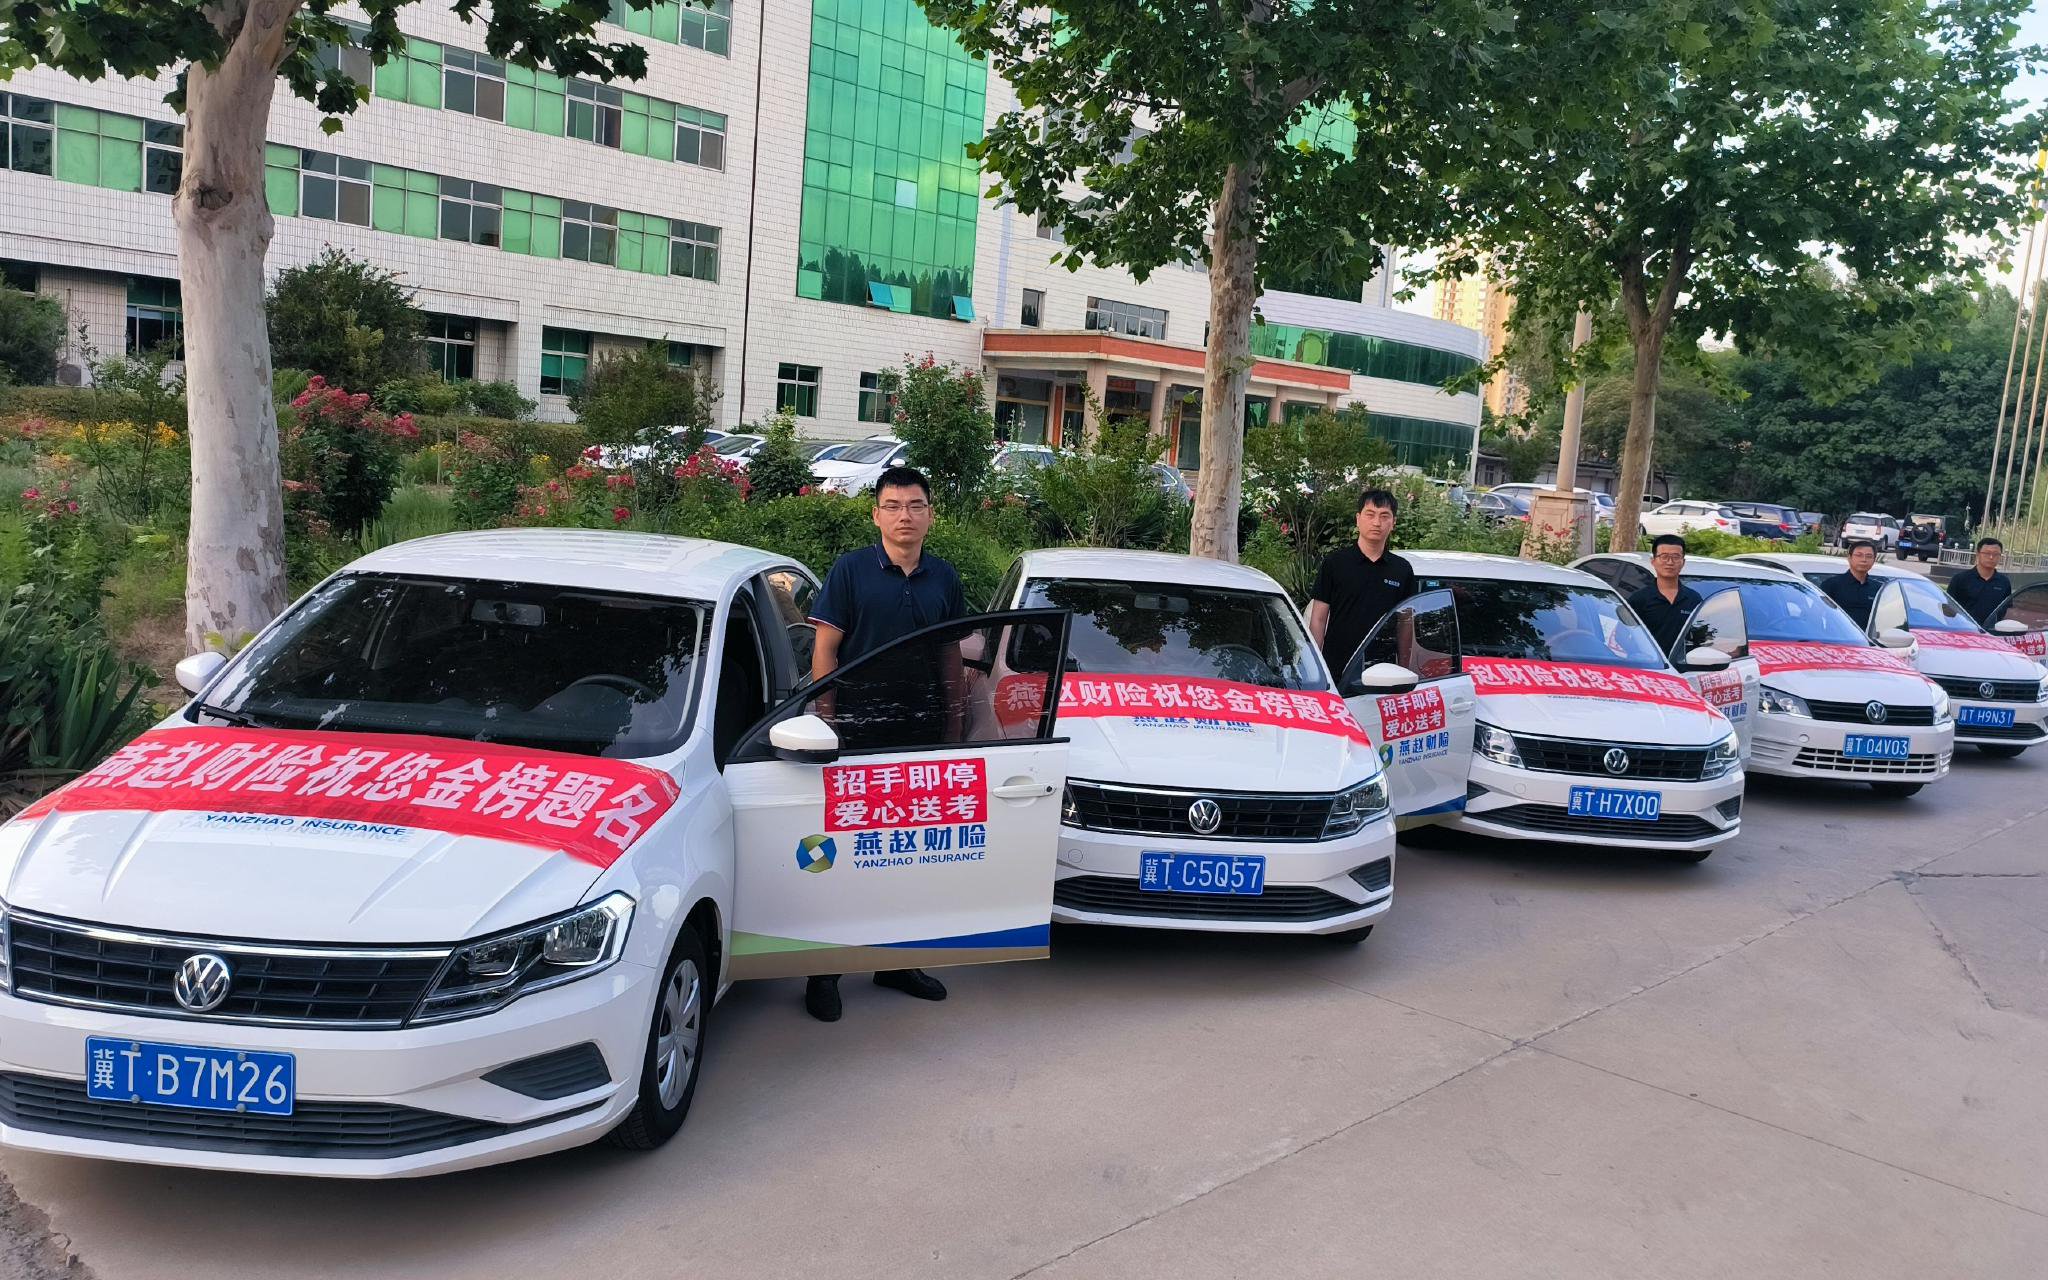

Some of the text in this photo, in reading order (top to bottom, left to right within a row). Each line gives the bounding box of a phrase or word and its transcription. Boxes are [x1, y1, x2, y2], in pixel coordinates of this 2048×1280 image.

[1381, 690, 1440, 717] 招手即停
[1386, 710, 1443, 738] 爱心送考
[833, 763, 978, 796] 招手即停
[73, 740, 658, 850] 燕赵财险祝您金榜题名
[206, 814, 407, 836] YANZHAO INSURANCE
[834, 794, 979, 828] 爱心送考
[854, 824, 986, 857] 燕赵财险
[854, 852, 985, 869] YANZHAO INSURANCE
